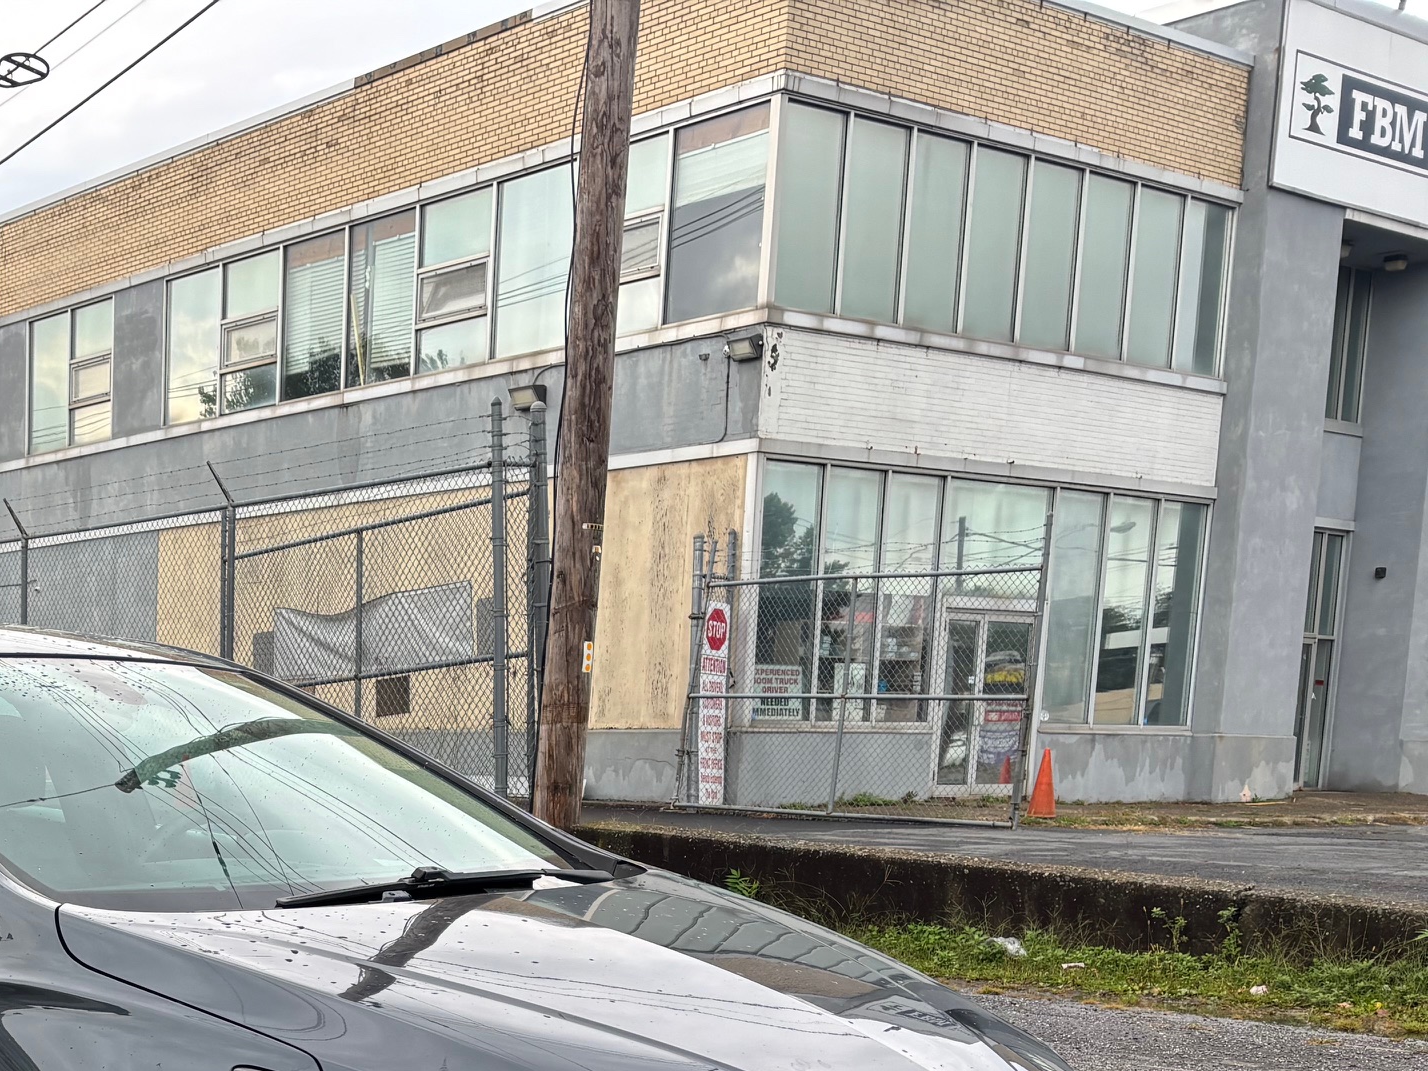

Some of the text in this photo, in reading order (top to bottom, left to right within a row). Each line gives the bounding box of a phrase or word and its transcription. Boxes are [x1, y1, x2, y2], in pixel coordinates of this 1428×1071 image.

[1348, 89, 1427, 159] FBM
[707, 620, 726, 639] STOP
[701, 656, 726, 674] ATTENTION
[754, 668, 801, 677] XPERIENCED
[774, 677, 799, 686] TRUCK
[762, 685, 789, 694] DRIVER
[760, 697, 790, 707] NEEDED
[752, 707, 801, 717] MMEDIATELY
